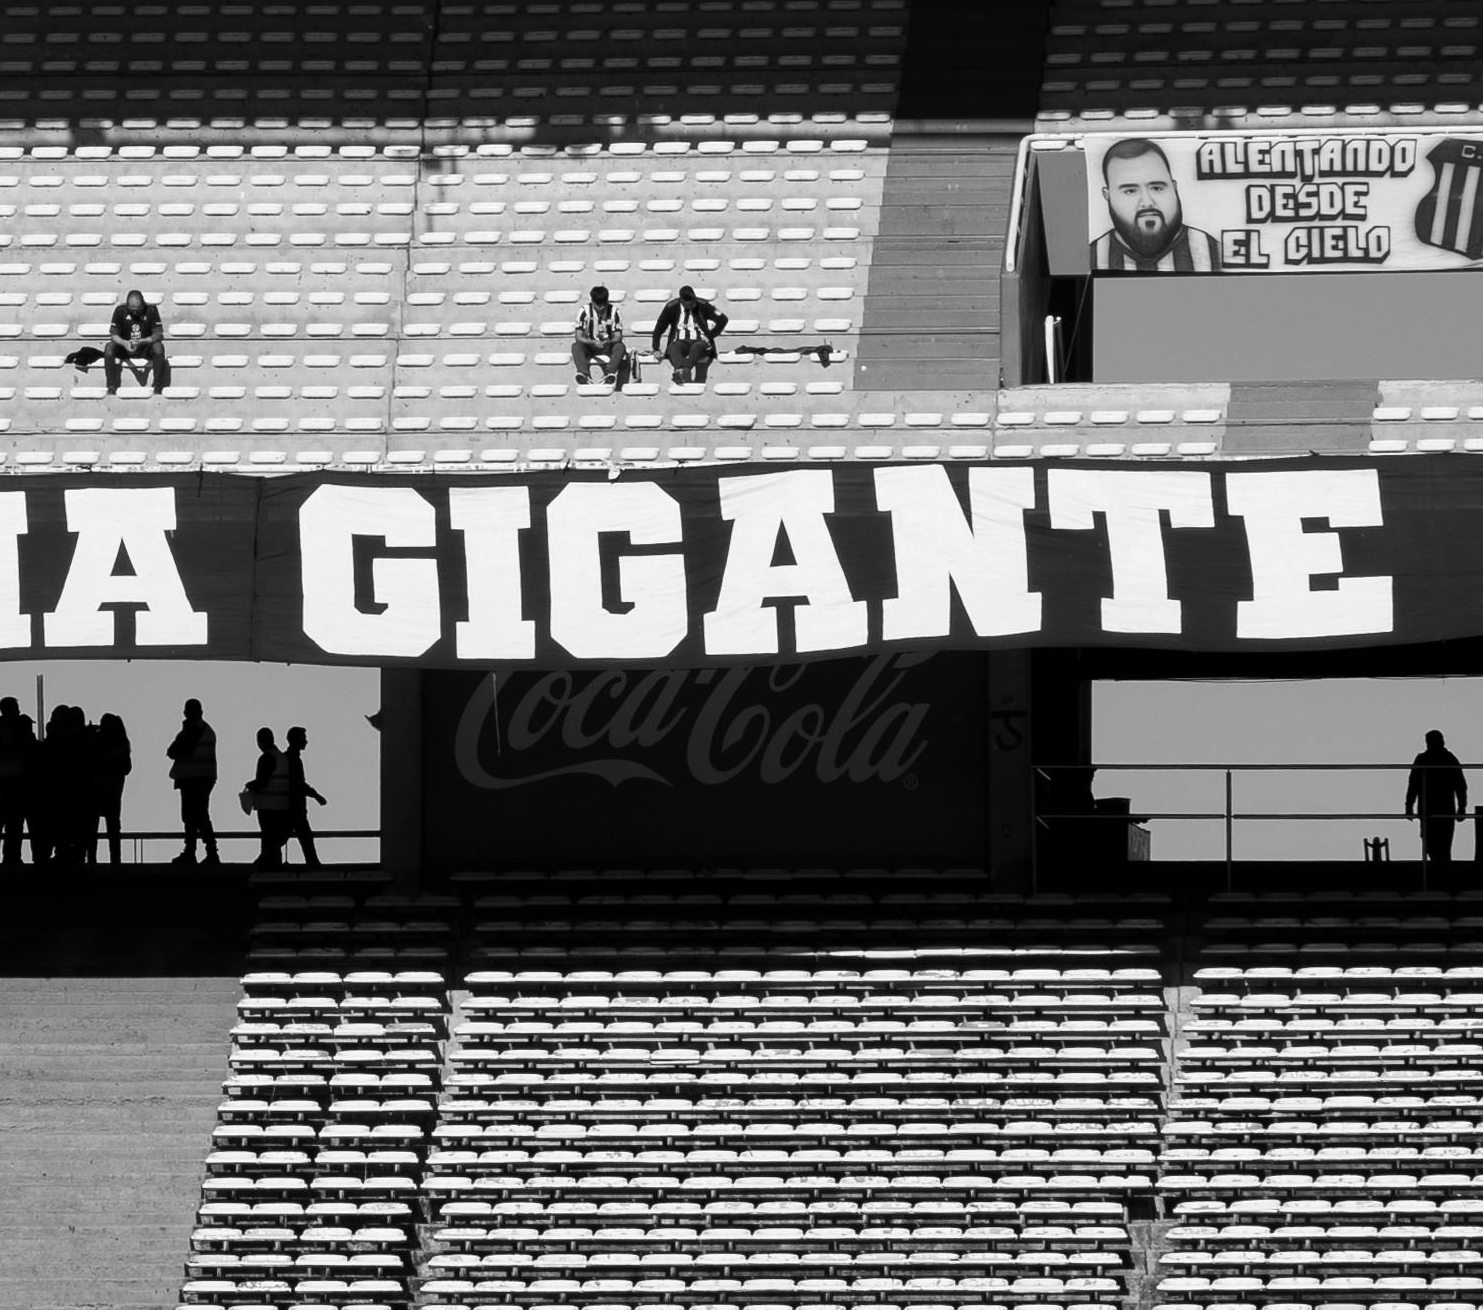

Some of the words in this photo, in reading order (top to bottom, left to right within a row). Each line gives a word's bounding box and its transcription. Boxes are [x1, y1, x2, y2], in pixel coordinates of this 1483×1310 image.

[1196, 139, 1417, 182] ALENTANDO
[1245, 182, 1370, 224] DESDE
[1221, 229, 1270, 269] EL
[1285, 226, 1391, 265] CIELO
[298, 463, 1394, 660] GIGANTE
